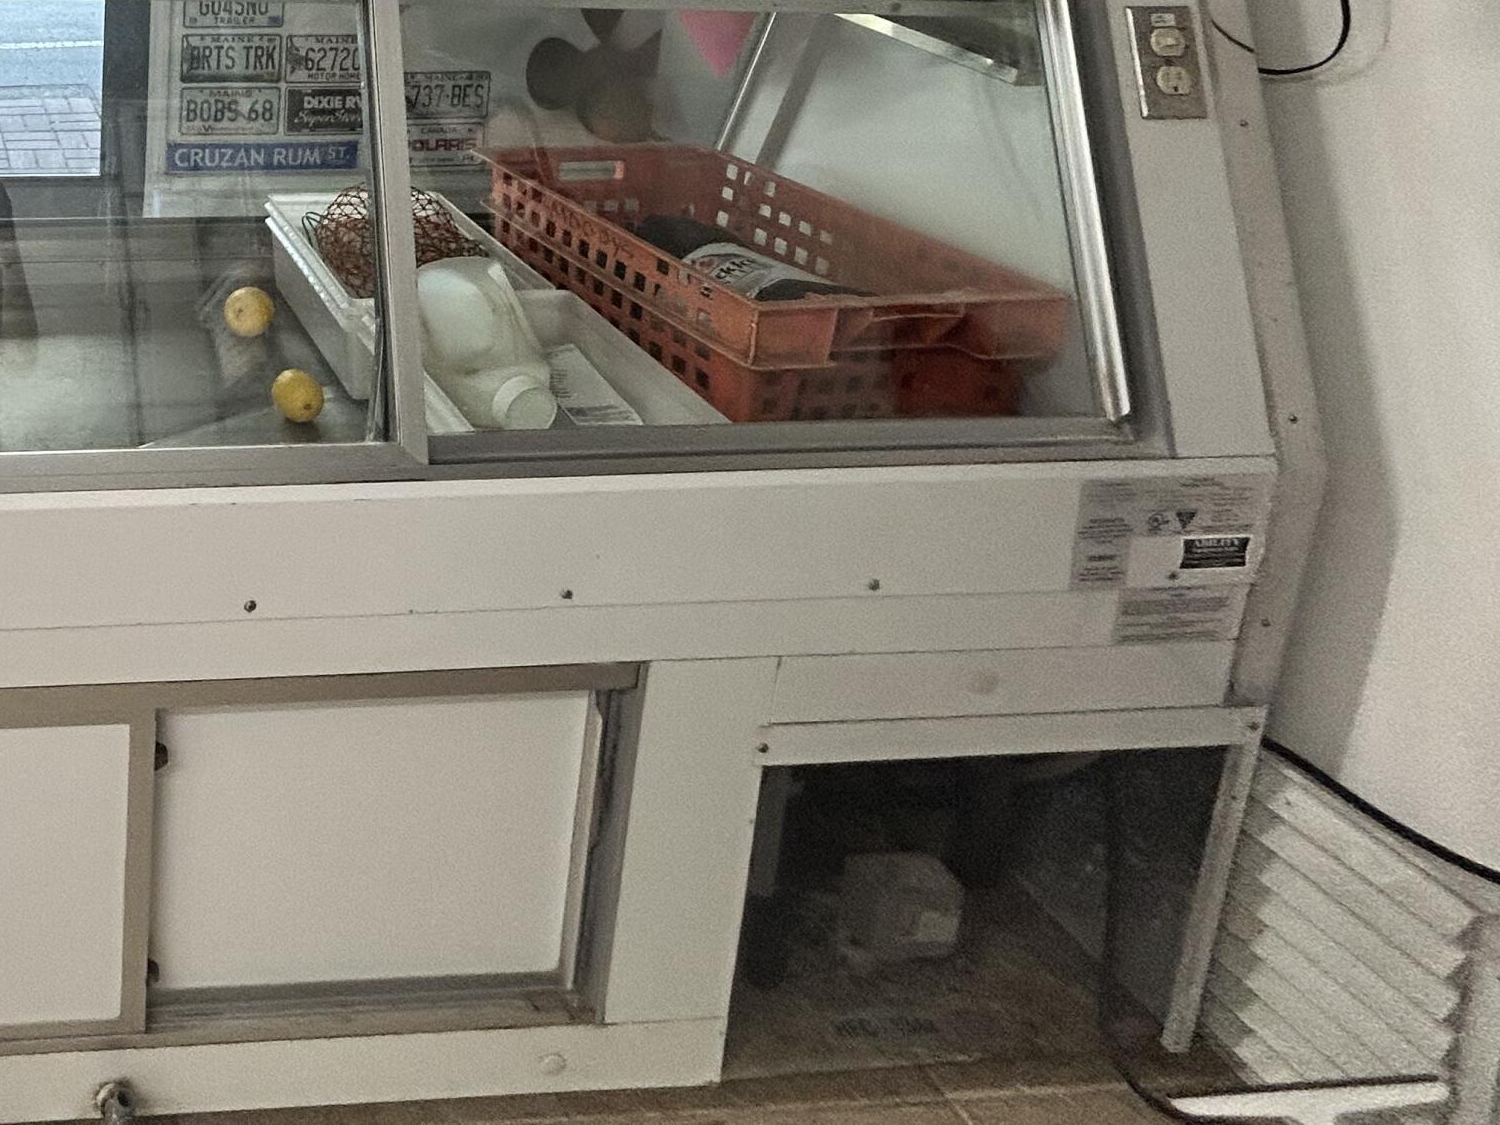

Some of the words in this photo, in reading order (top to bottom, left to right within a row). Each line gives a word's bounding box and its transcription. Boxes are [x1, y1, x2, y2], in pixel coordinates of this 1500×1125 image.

[243, 46, 276, 71] TRK
[303, 96, 343, 109] DIXIE
[174, 147, 265, 168] CRUZAN
[273, 146, 323, 166] RUM
